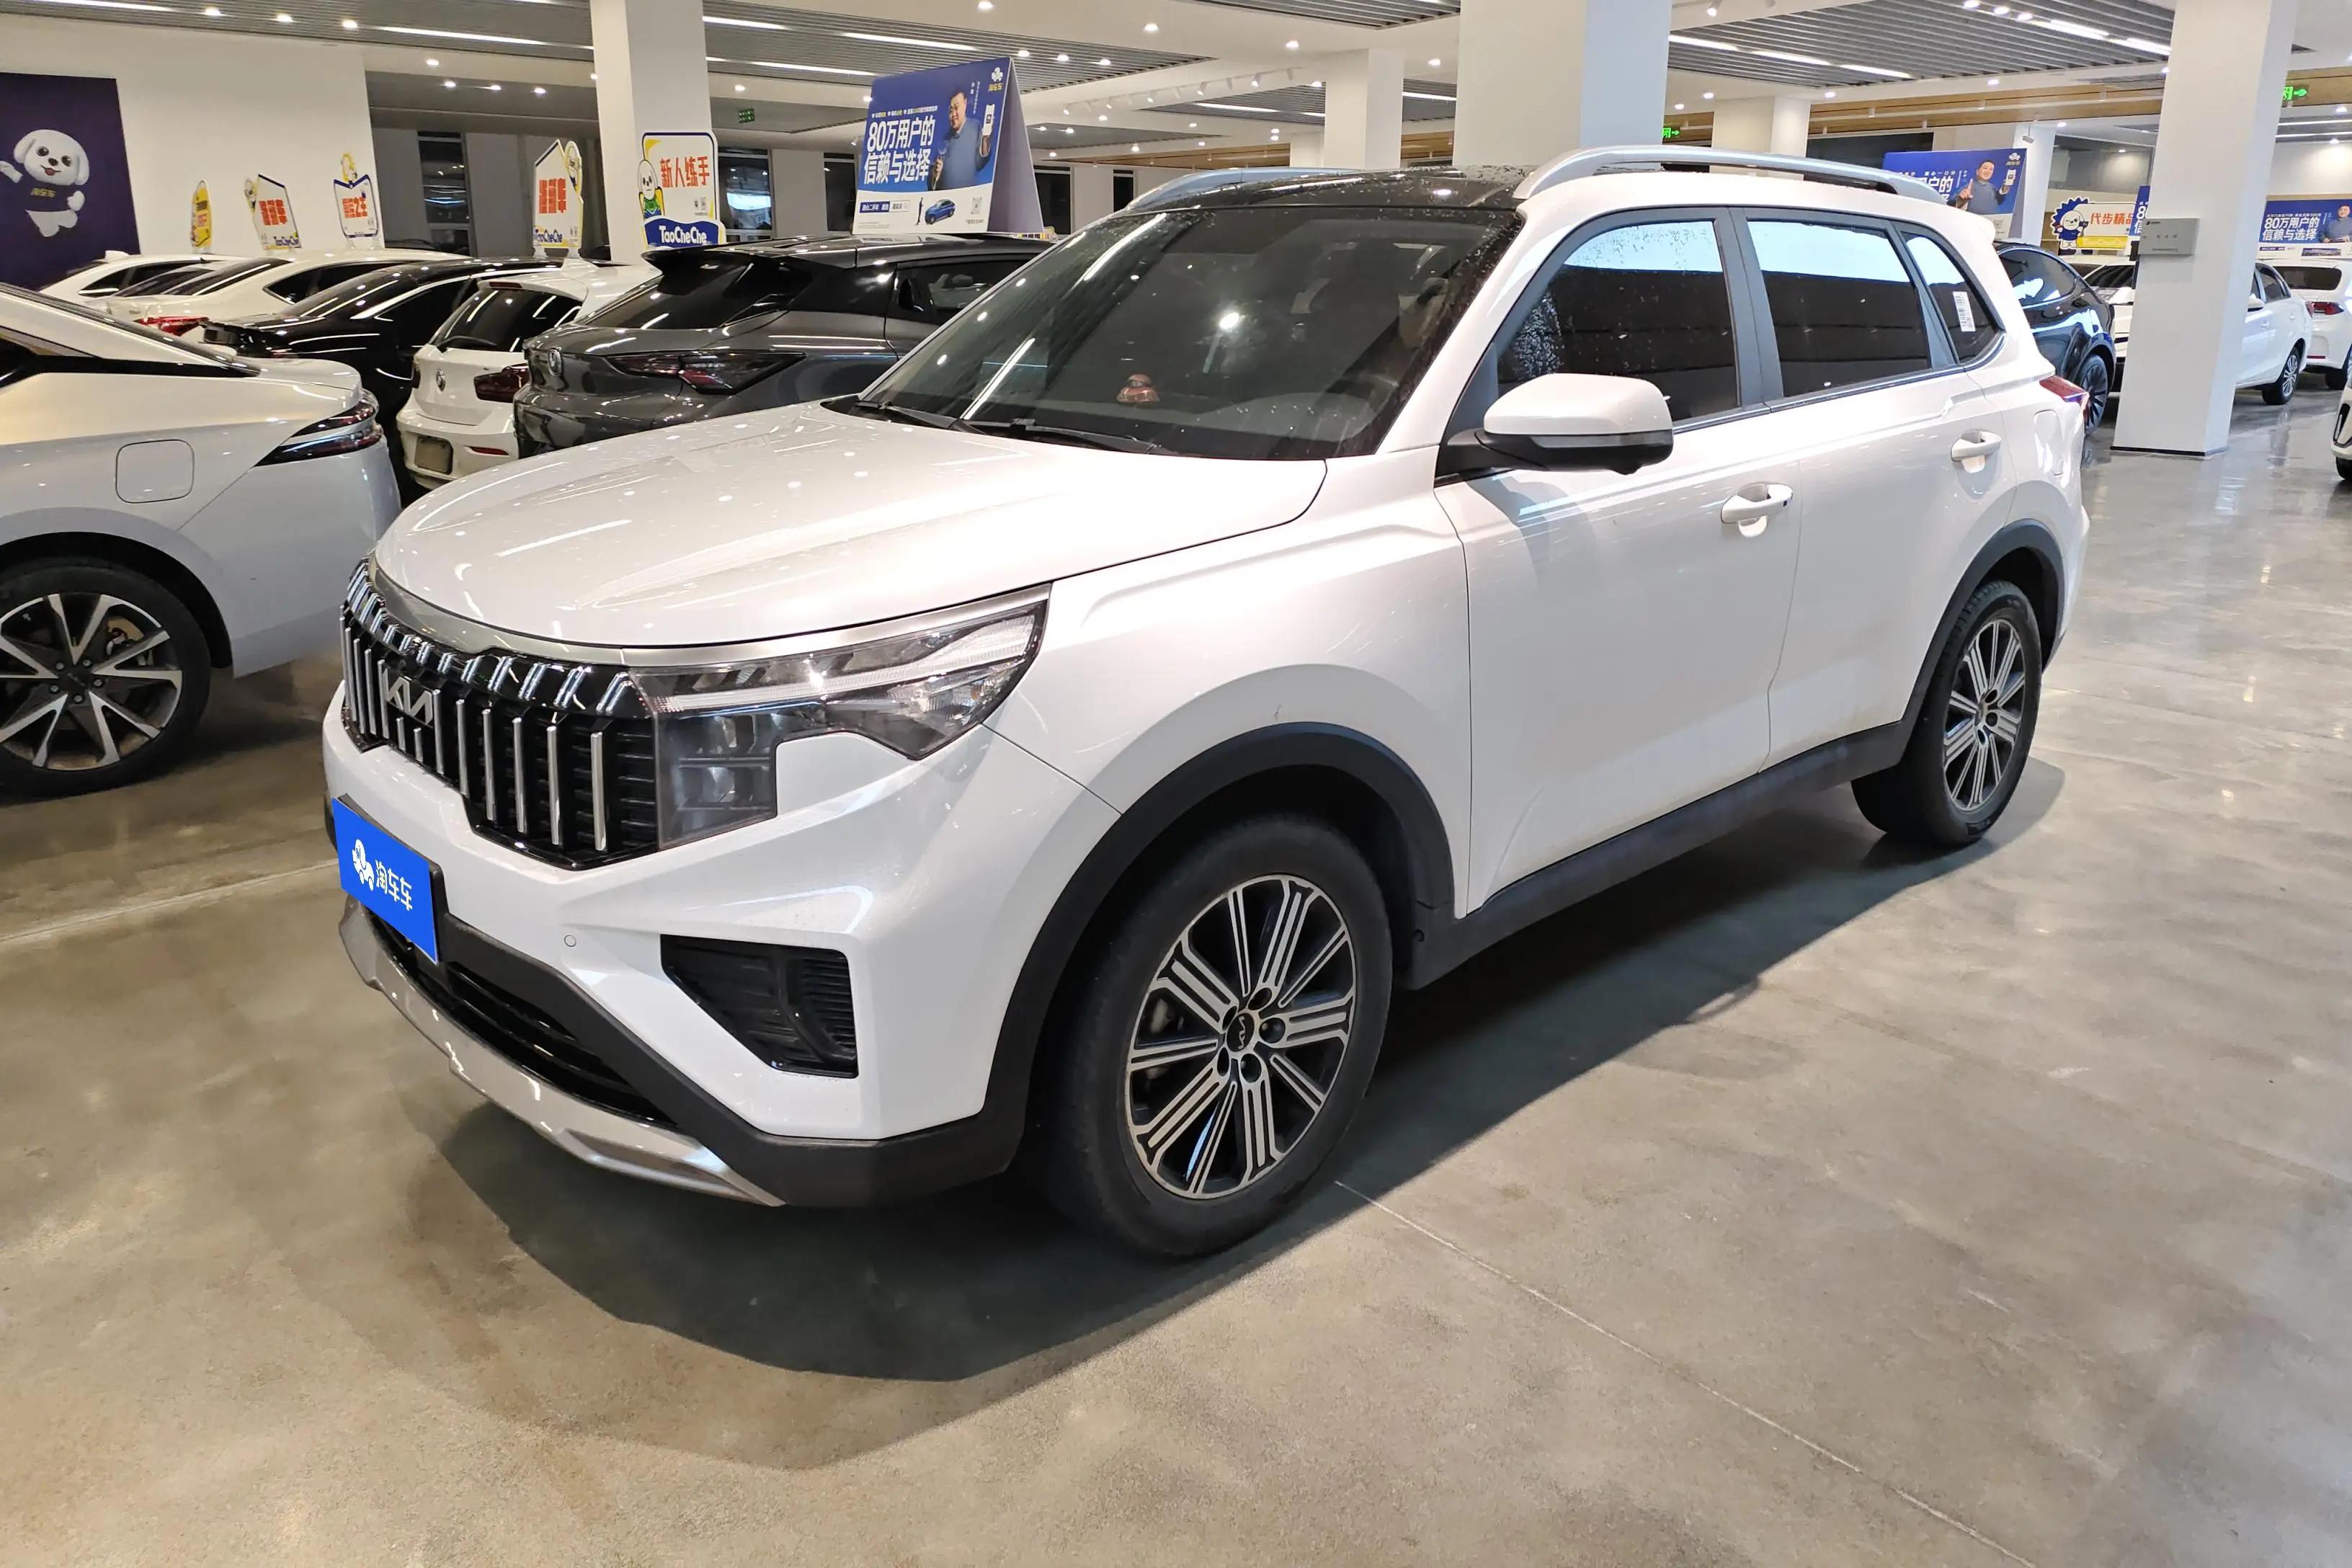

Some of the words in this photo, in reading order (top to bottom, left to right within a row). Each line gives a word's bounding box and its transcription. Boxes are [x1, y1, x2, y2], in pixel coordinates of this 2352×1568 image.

[867, 115, 936, 152] 80万用户的
[660, 156, 710, 188] 新人练手
[864, 148, 931, 184] 信赖与选择
[659, 225, 708, 244] TaoCheChe
[2263, 228, 2317, 241] 信赖与选择
[2264, 217, 2320, 229] 80万用户的
